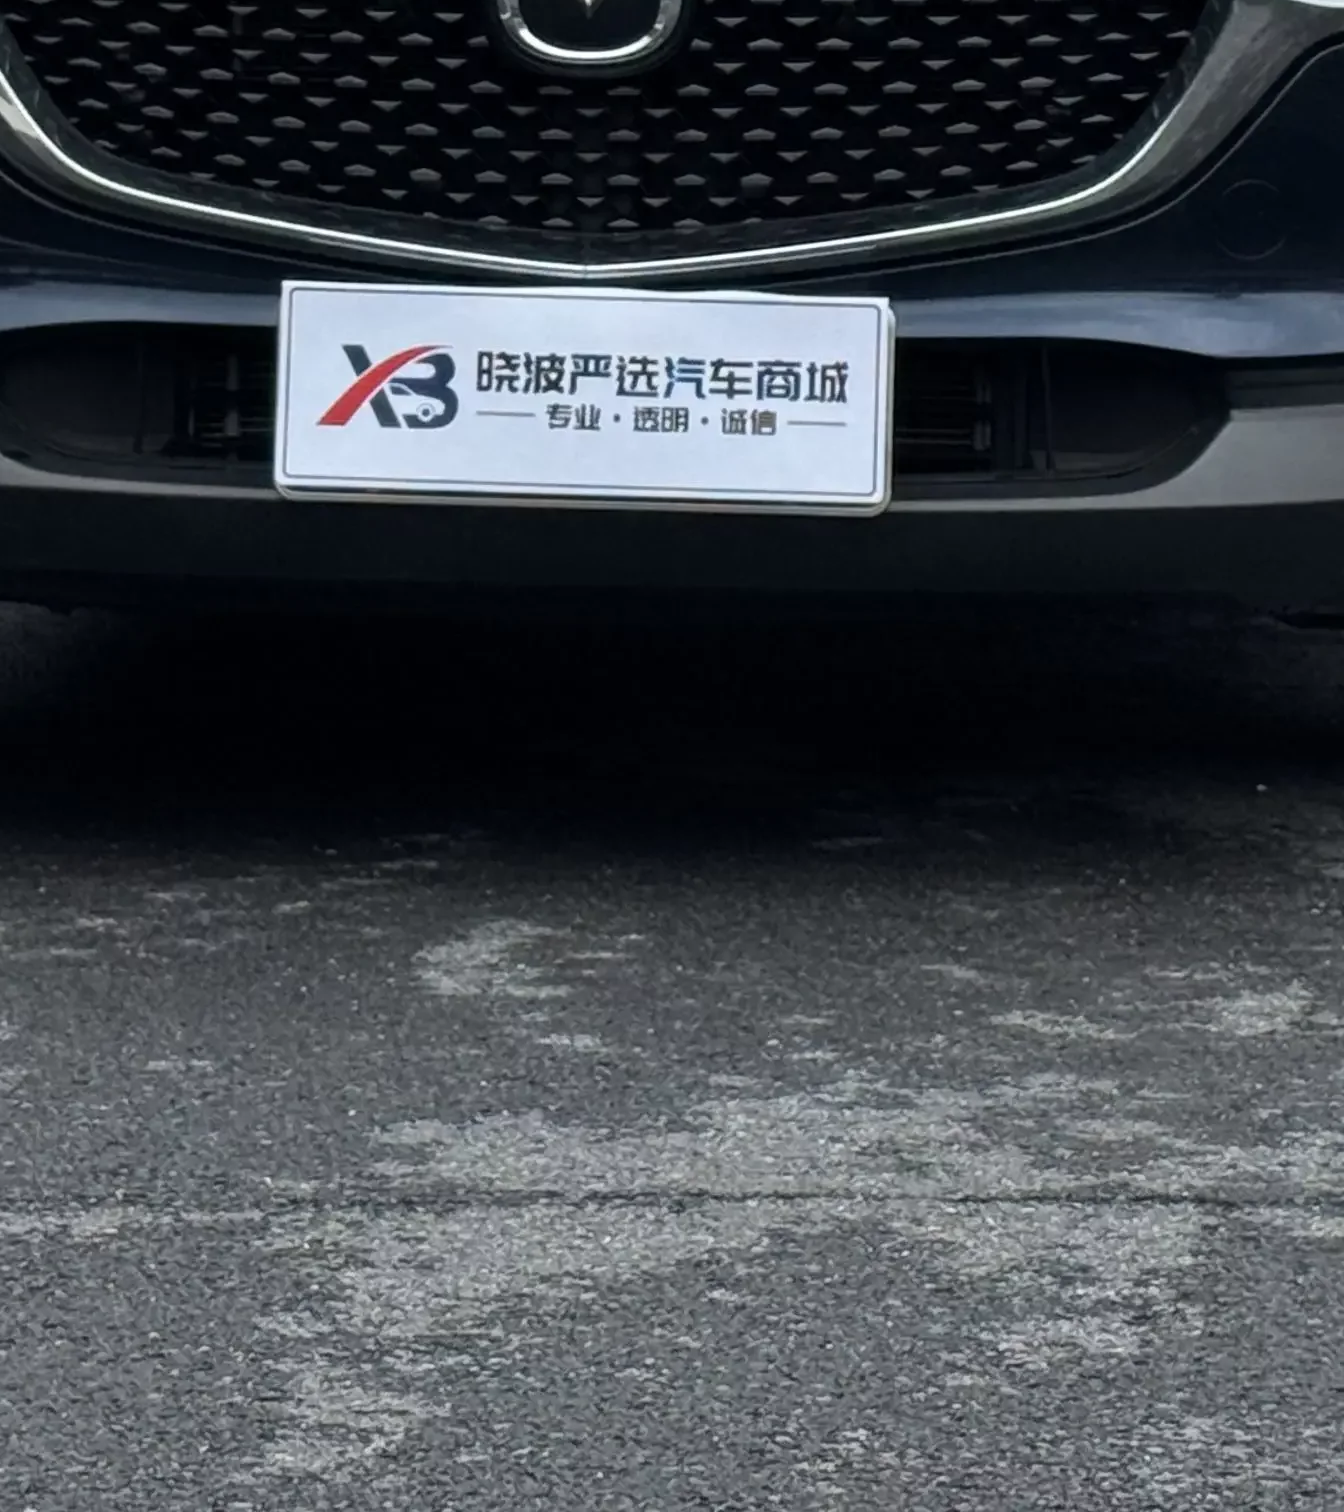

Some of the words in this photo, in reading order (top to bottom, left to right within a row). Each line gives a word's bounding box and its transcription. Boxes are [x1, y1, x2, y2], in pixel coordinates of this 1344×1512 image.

[476, 350, 849, 404] 晓波严选汽车商城
